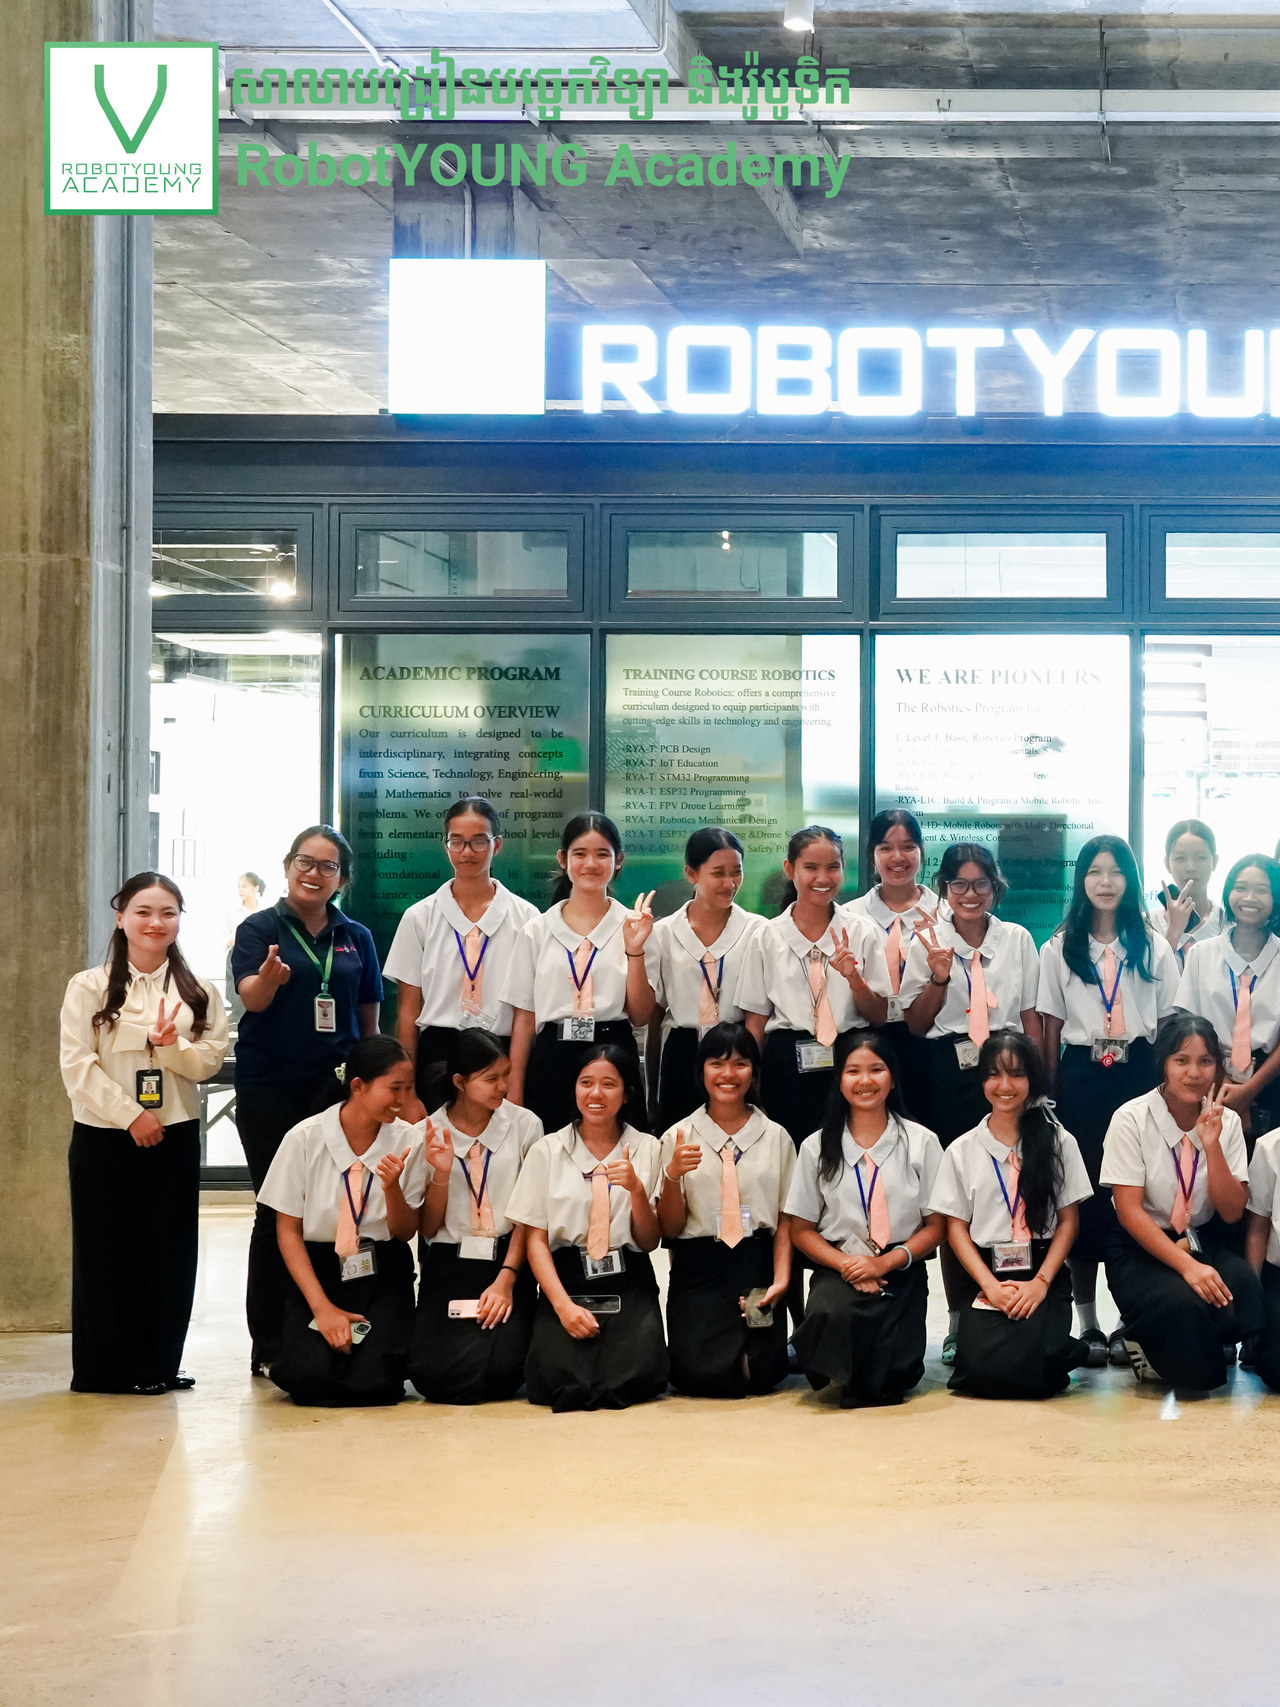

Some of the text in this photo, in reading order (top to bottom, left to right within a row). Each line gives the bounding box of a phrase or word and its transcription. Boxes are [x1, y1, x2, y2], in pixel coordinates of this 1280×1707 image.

[359, 667, 561, 681] ACADEMIC PROGRAM
[623, 668, 836, 682] TRAINING COURSE ROBOTICS
[896, 668, 1102, 685] WE ARE PIONEERS
[623, 688, 659, 698] Training
[662, 688, 692, 697] Course
[694, 688, 735, 697] Robotics:
[738, 688, 762, 697] offers
[772, 688, 836, 698] comprehensive
[359, 705, 561, 718] CURRICULUM OVERVIEW
[622, 702, 669, 712] curriculum
[672, 702, 710, 713] designed
[712, 703, 721, 712] to
[723, 702, 747, 713] equip
[750, 702, 799, 713] participants
[896, 702, 917, 713] The
[922, 702, 970, 713] Robotics
[975, 702, 1023, 716] Program
[622, 717, 676, 728] cutting-edge
[678, 717, 700, 726] skills
[703, 717, 712, 726] in
[714, 717, 761, 728] technology
[764, 717, 779, 726] and
[359, 728, 564, 740] Our curriculum is designed to be
[906, 734, 931, 742] Level
[1014, 734, 1052, 744] Program
[359, 749, 564, 761] interdisciplinary, integrating concepts
[660, 745, 680, 754] PCB
[682, 745, 711, 756] Design
[660, 760, 675, 768] IoT
[678, 760, 719, 768] Education
[358, 768, 384, 778] from
[388, 769, 429, 780] Science,
[498, 768, 564, 781] Engineering,
[660, 774, 692, 782] STM32
[694, 774, 750, 784] Programming
[358, 789, 564, 798] and Mathematics to solve real-world
[660, 788, 688, 796] ESP32
[690, 788, 746, 798] Programming
[660, 802, 678, 810] FPV
[680, 802, 706, 810] Drone
[709, 802, 746, 812] Learning
[944, 796, 965, 805] Build
[967, 796, 974, 805] &
[978, 796, 1012, 807] Program
[1020, 796, 1049, 805] Mobile
[1051, 796, 1081, 805] Robotic
[414, 810, 431, 818] We
[514, 810, 564, 821] programs
[660, 816, 696, 824] Robotics
[698, 816, 746, 824] Mechanical
[749, 816, 778, 826] Design
[944, 822, 972, 830] Mobile
[974, 822, 1002, 830] Robots
[950, 834, 984, 842] Wireless
[748, 844, 774, 855] Safety
